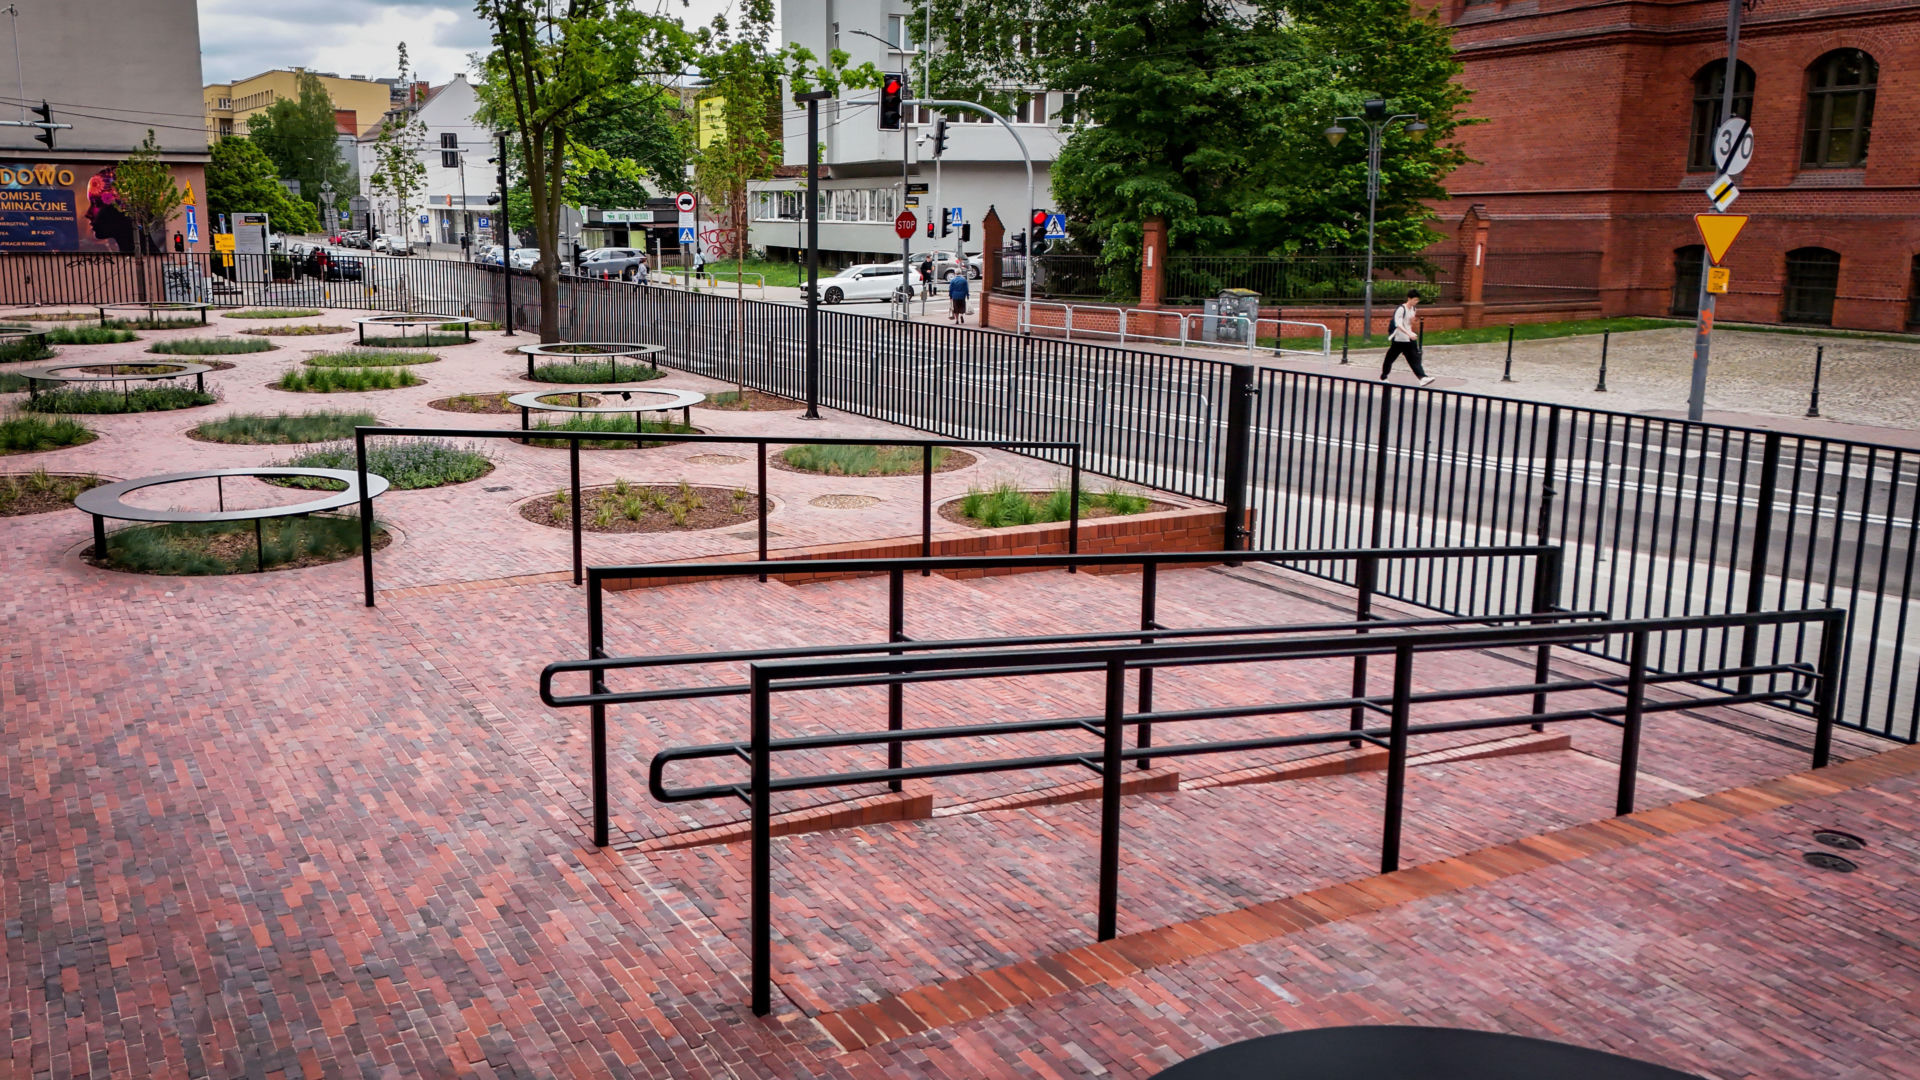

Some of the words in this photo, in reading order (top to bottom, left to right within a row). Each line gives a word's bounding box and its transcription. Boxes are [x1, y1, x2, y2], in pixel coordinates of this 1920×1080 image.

[1720, 130, 1753, 159] 30
[0, 169, 75, 186] DOWO
[0, 192, 42, 200] OMISJE
[897, 220, 916, 230] STOP
